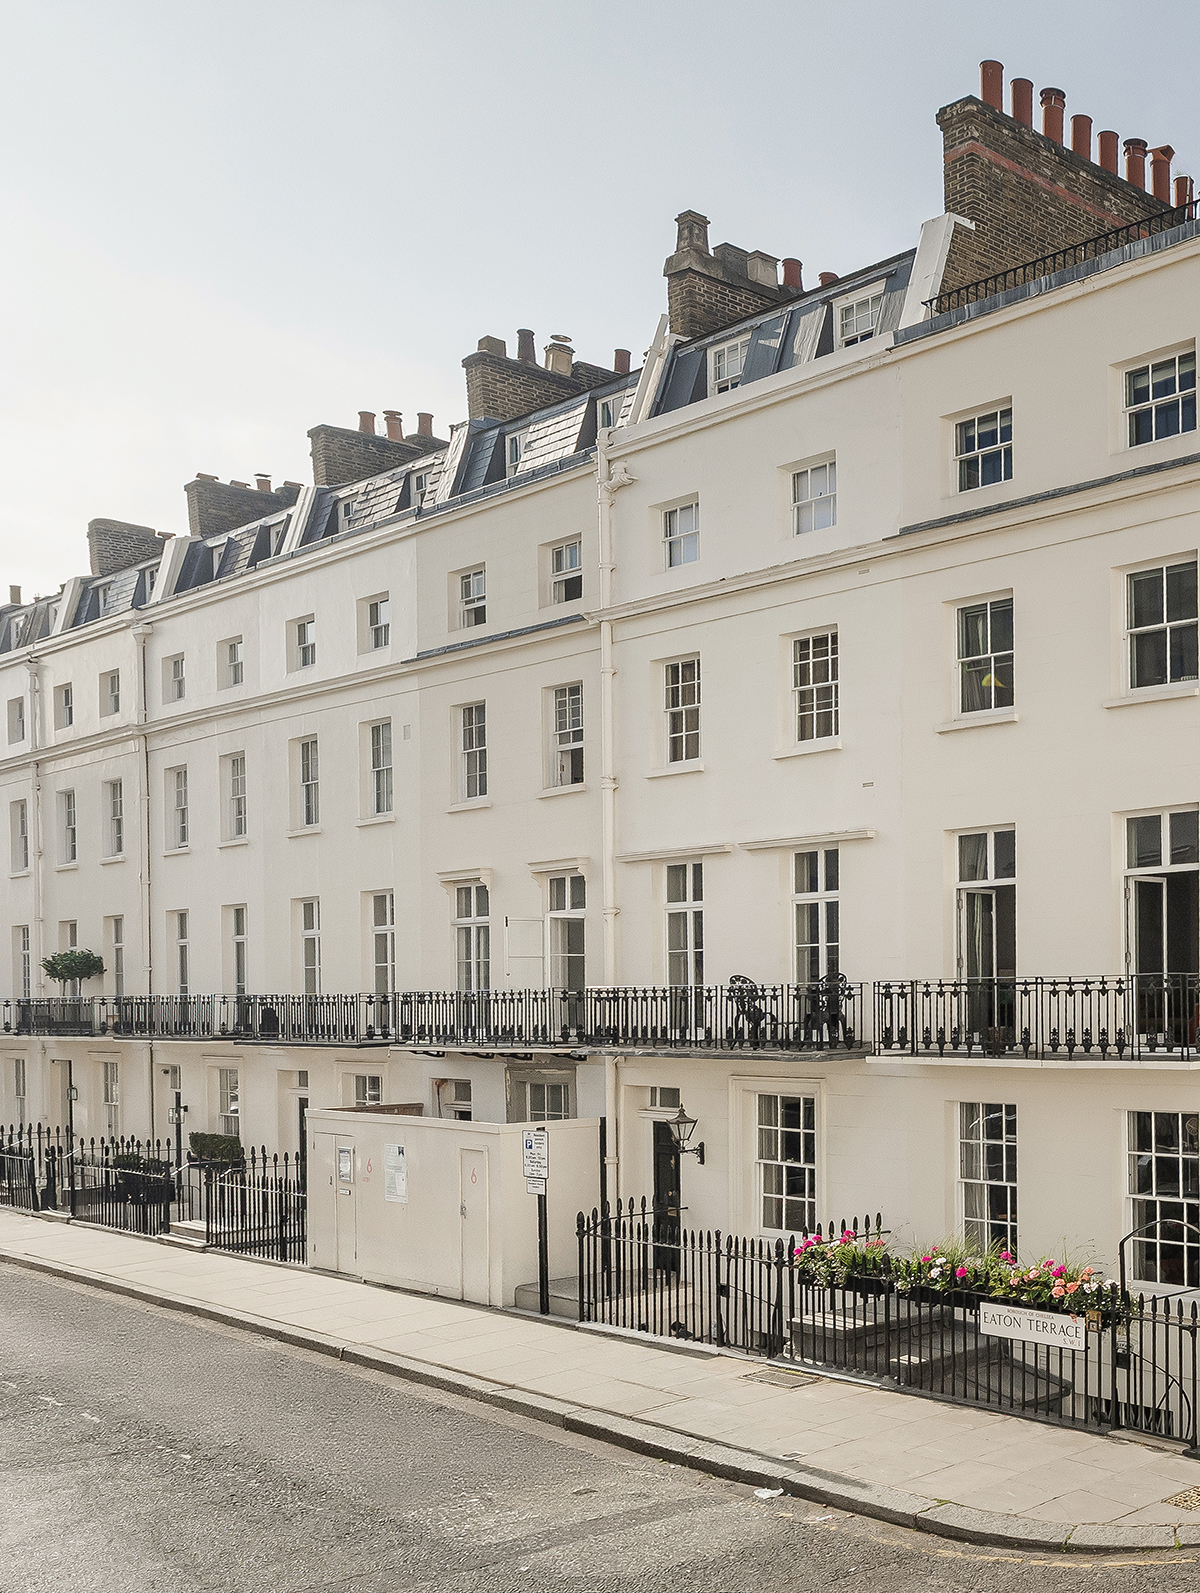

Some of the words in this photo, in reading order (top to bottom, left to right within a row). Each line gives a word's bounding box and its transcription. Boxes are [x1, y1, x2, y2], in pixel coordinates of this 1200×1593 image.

[366, 1158, 373, 1174] 6
[470, 1167, 478, 1184] 6
[1007, 1308, 1027, 1317] BOROUGH
[1035, 1312, 1055, 1320] CHELSEA
[983, 1311, 1022, 1329] EATON
[1026, 1318, 1081, 1339] TERRACE
